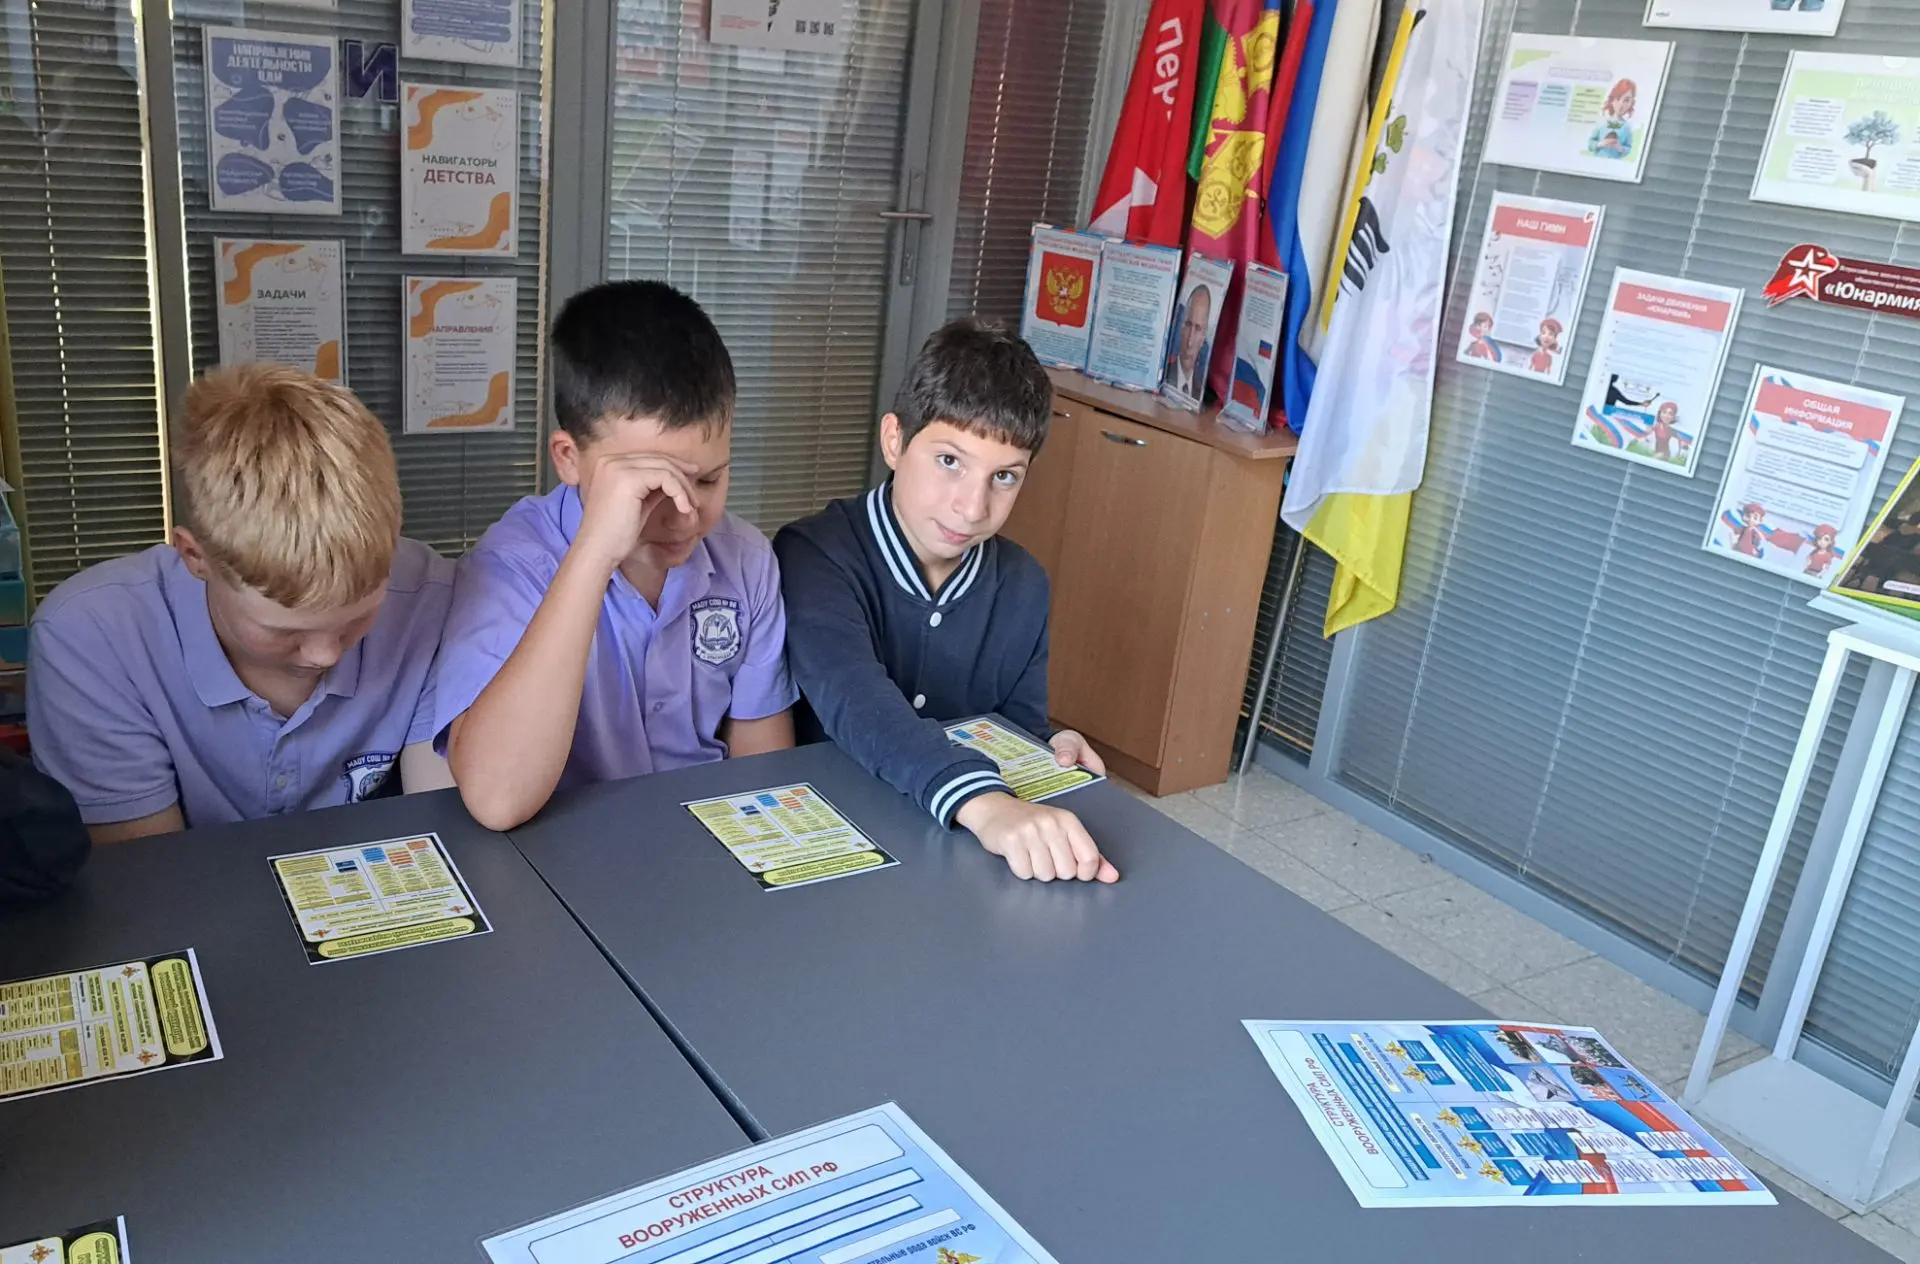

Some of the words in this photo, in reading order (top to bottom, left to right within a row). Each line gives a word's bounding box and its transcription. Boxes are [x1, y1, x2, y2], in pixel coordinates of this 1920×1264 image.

[422, 153, 497, 168] НАВИГАТОРЫ
[423, 168, 496, 185] ДЕТСТВА
[257, 289, 307, 300] ЗАДАЧИ
[1784, 406, 1853, 429] ИНФОРМАЦИЯ
[1803, 398, 1841, 414] ОБЩАЯ
[1306, 1082, 1345, 1128] СТРУКТУРА
[1326, 1088, 1379, 1155] ВООРУЖЕННЫХ
[669, 1165, 773, 1209] СТРУКТУРА
[618, 1184, 771, 1249] ВООРУЖЕННЫХ
[809, 1161, 839, 1178] РФ
